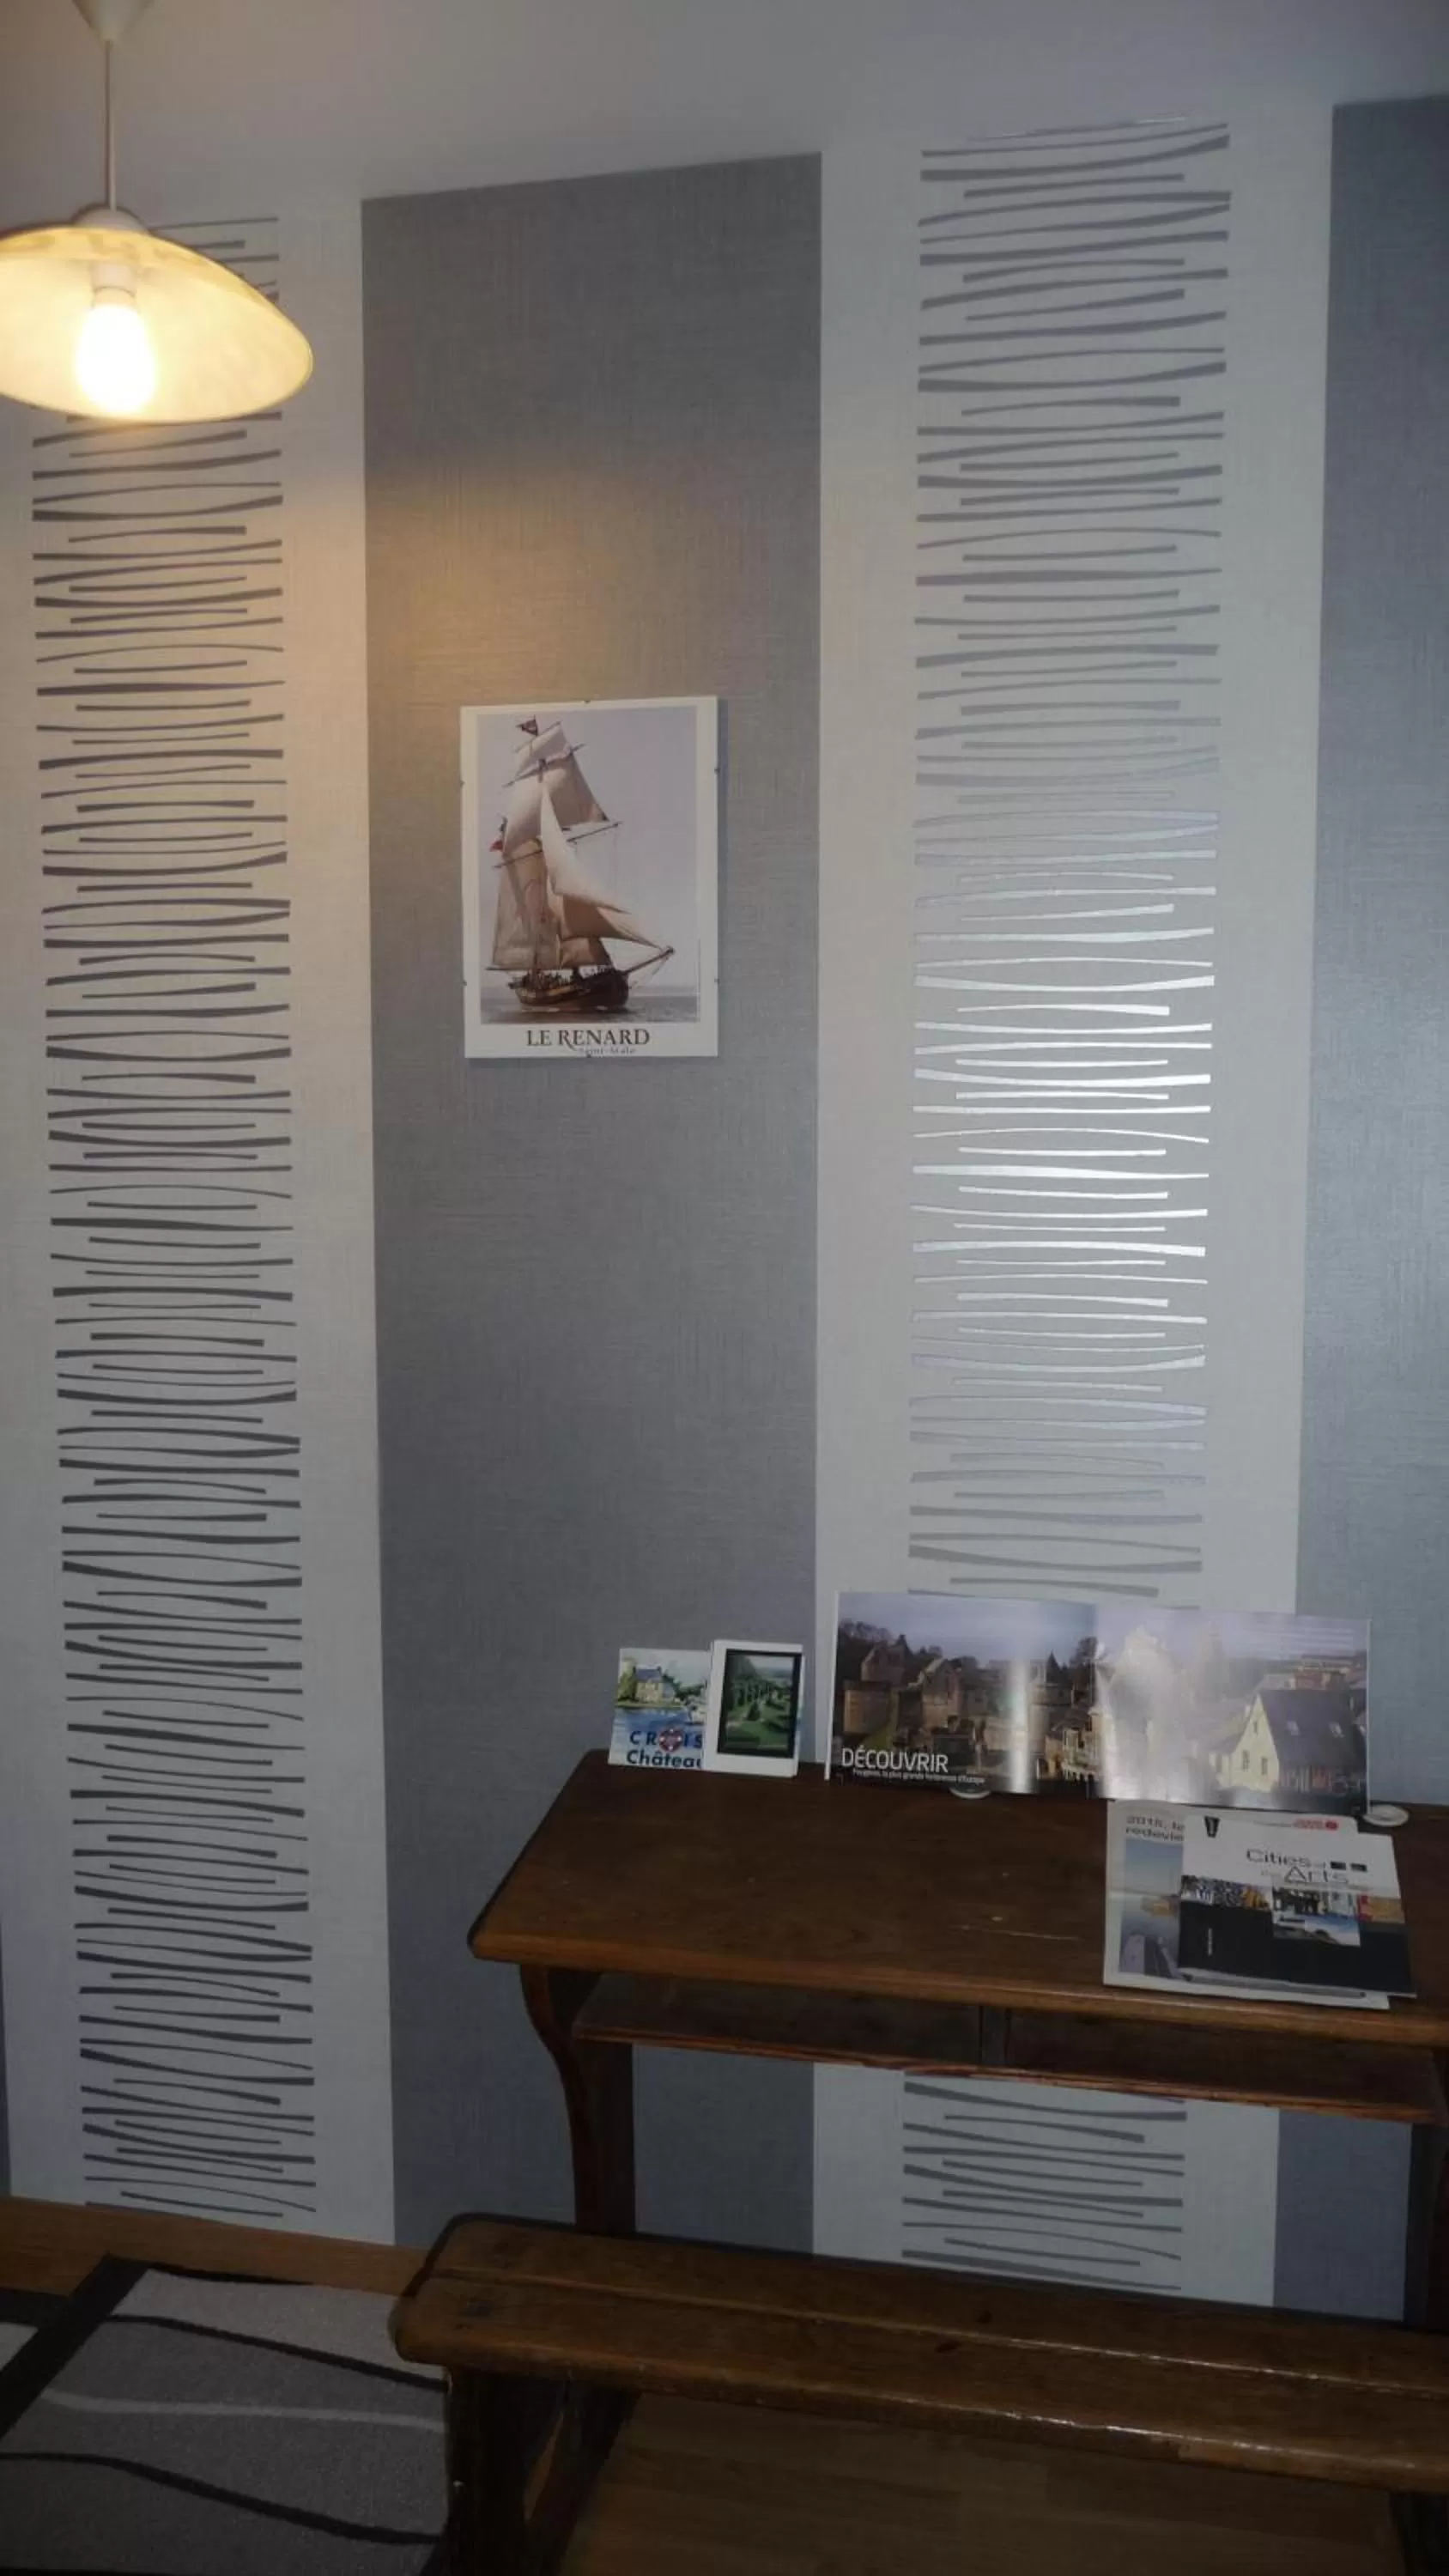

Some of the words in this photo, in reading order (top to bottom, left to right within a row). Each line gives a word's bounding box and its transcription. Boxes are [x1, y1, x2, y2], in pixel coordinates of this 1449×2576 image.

[526, 1030, 552, 1047] LE
[559, 1029, 650, 1051] RENARD
[841, 1745, 949, 1773] DÉCOUVRIR
[1246, 1849, 1312, 1868] Cities
